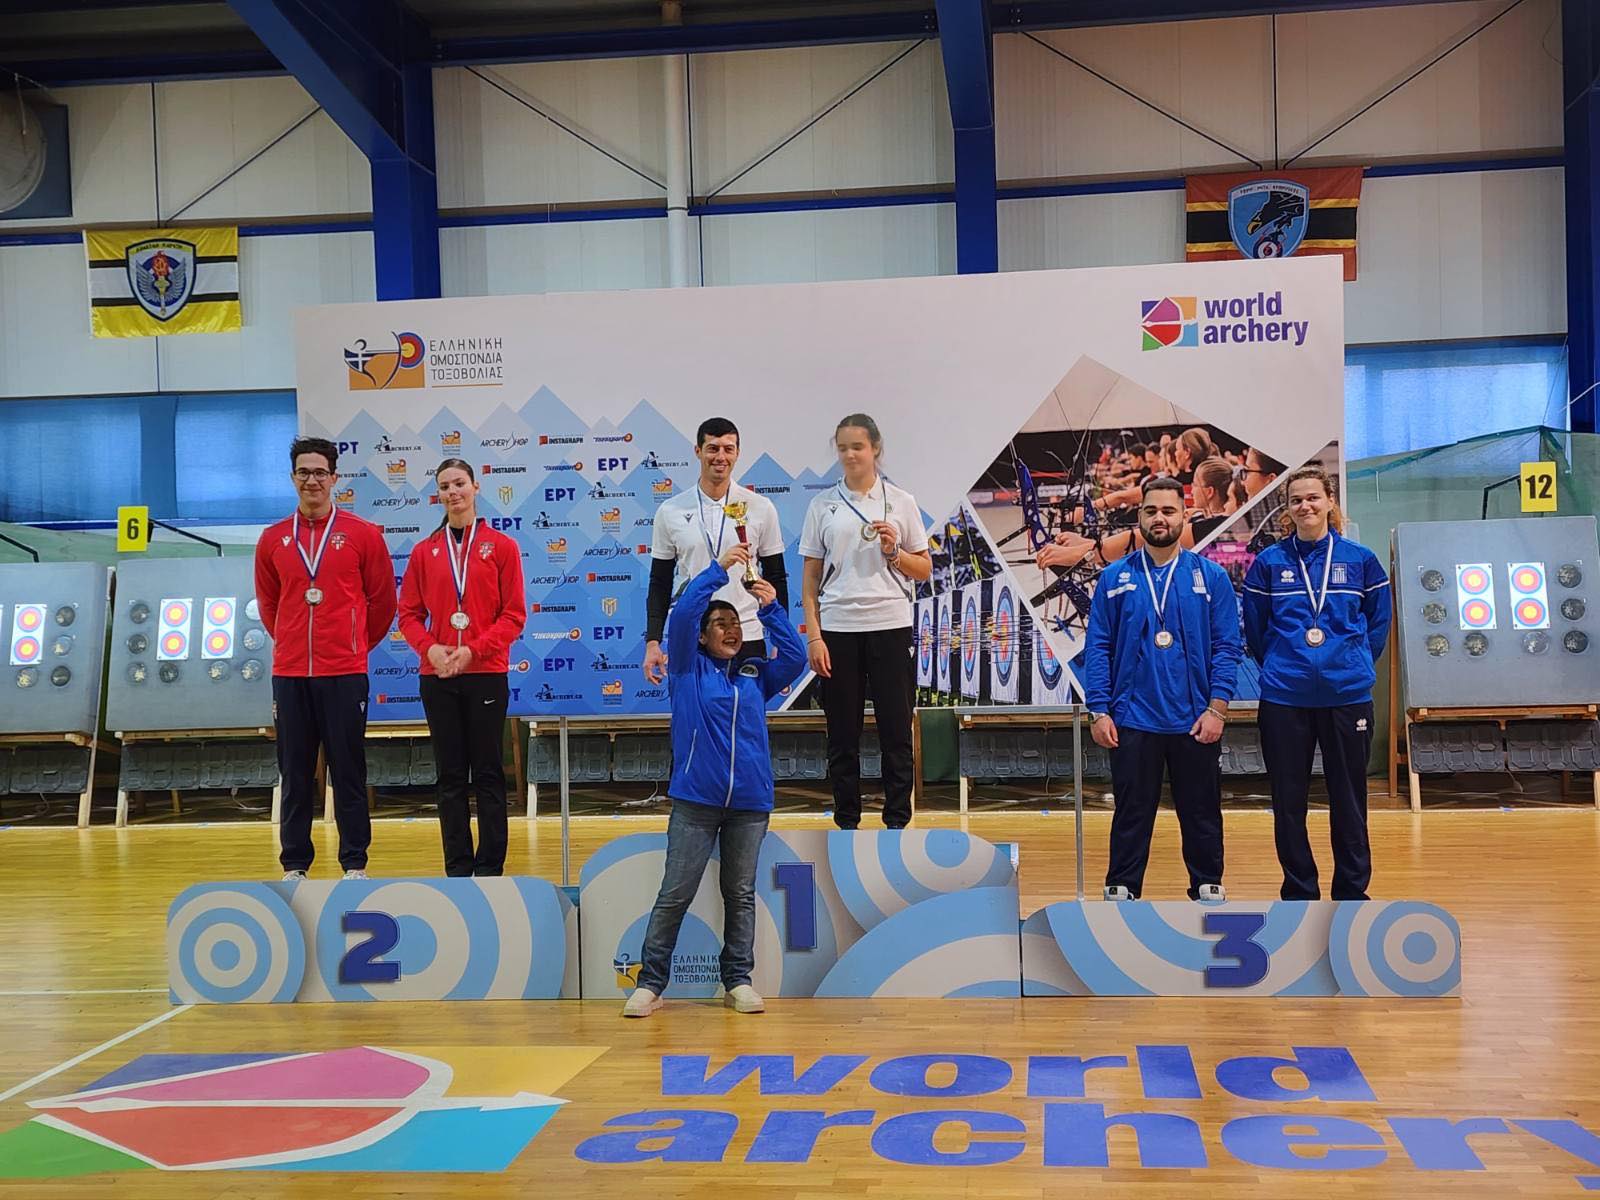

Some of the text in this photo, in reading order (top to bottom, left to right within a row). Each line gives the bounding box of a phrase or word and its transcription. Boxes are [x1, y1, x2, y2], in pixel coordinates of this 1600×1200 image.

[1204, 291, 1282, 318] world
[430, 338, 503, 351] ΕΛΛΗΝΙΚΗ
[1203, 318, 1309, 346] archery
[431, 352, 503, 366] ΟΜΟΣΠΟΝΔΙΑ
[432, 367, 503, 380] ΤΟΞΟΒΟΛΙΑΣ
[1525, 474, 1553, 499] 12
[127, 518, 139, 539] 6
[773, 862, 817, 949] 1
[339, 911, 401, 984] 2
[1203, 912, 1270, 988] 3
[673, 965, 720, 974] ΟΜΟΣΠΟΝΔΙ
[674, 975, 720, 983] ΤΟΞΟΒΟΛΙΑ
[661, 1044, 1378, 1102] world
